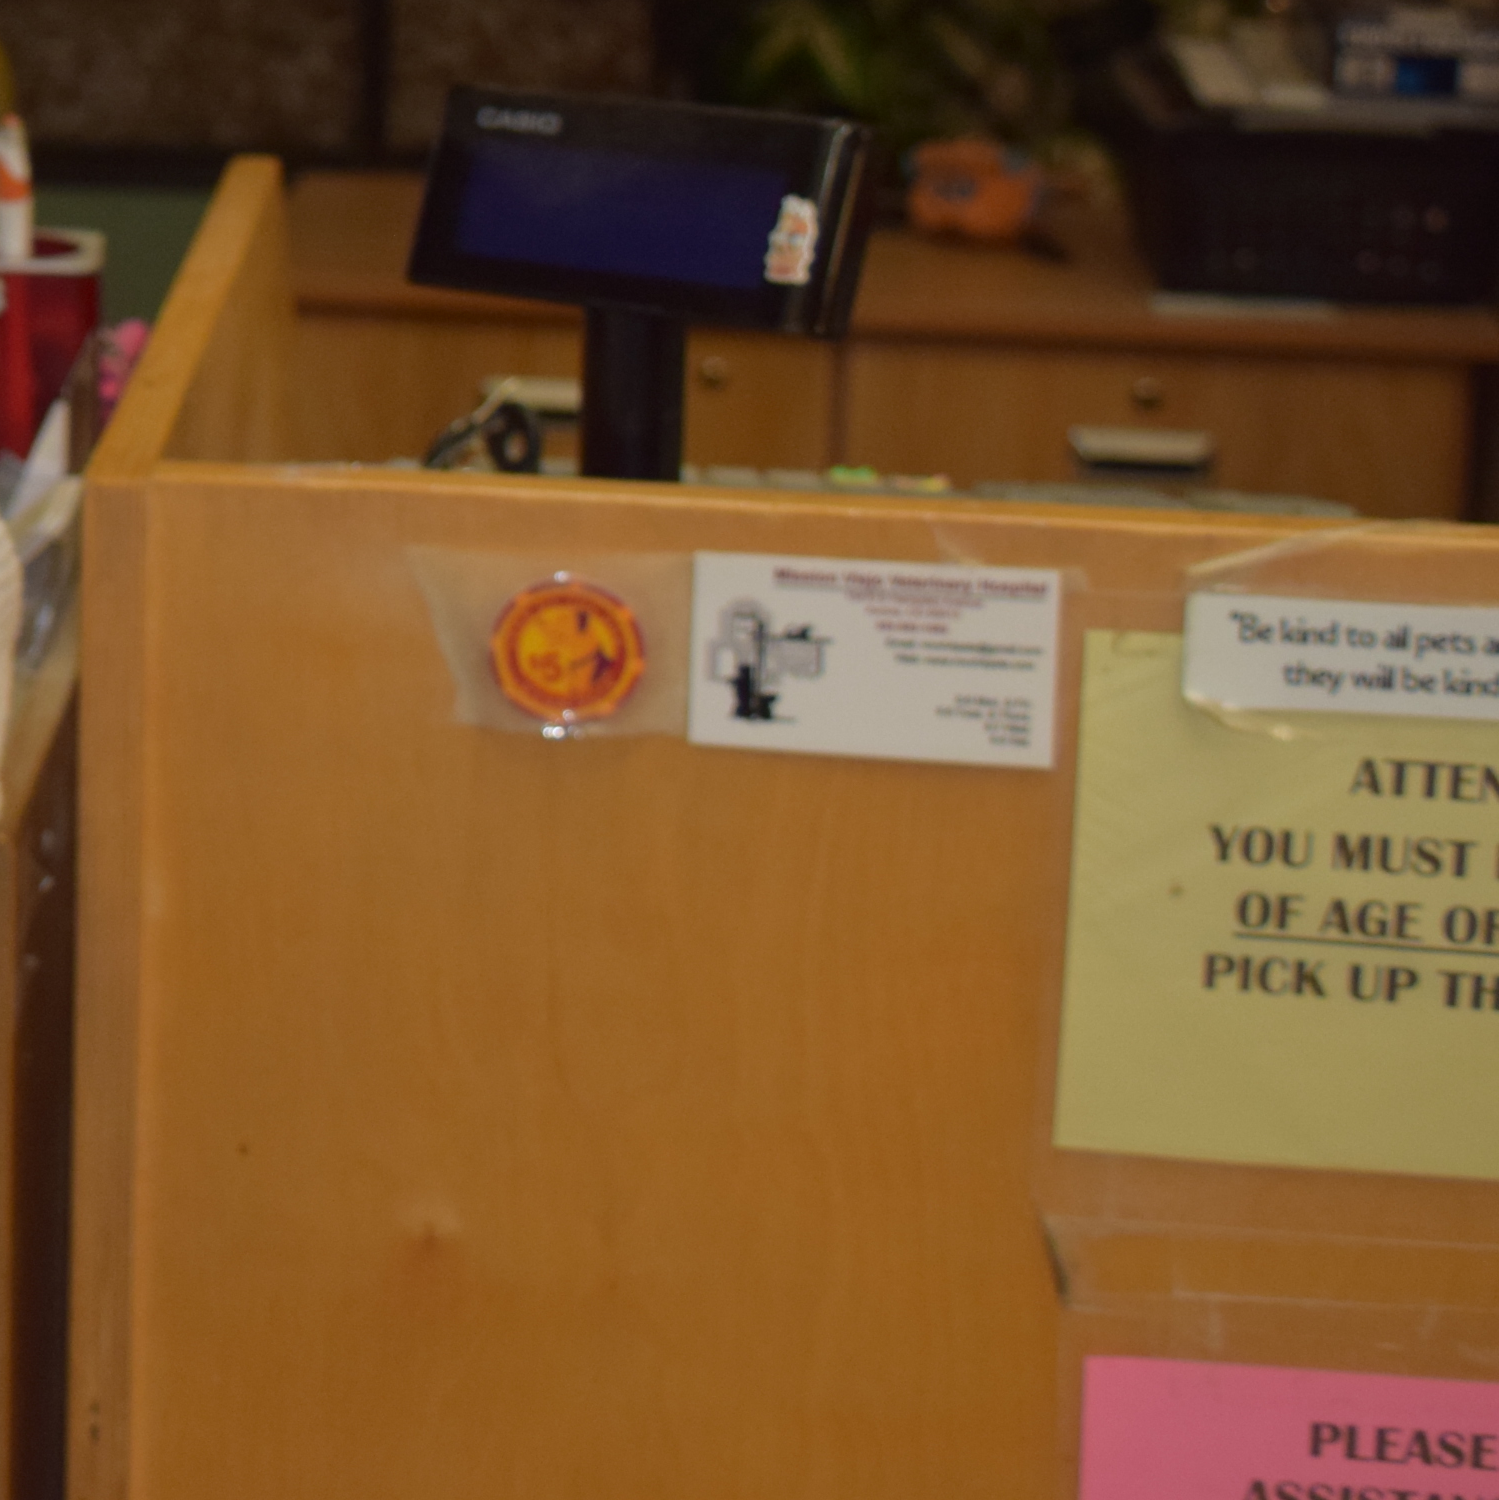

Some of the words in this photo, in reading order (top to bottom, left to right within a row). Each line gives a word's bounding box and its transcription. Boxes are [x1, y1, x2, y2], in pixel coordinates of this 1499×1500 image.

[476, 106, 562, 135] CASIO
[1280, 616, 1340, 646] kind
[1346, 624, 1378, 649] to
[1384, 623, 1411, 650] all
[1414, 632, 1476, 661] pets
[1283, 661, 1344, 695] they
[1352, 663, 1396, 690] will
[1402, 666, 1437, 693] be
[1208, 824, 1312, 869] YOU
[1331, 833, 1478, 879] MUST
[1236, 891, 1306, 931] OF
[1319, 899, 1424, 942] AGE
[1203, 953, 1328, 998] PICK
[1349, 964, 1419, 1004] UP
[1310, 1422, 1499, 1470] PLEASE
